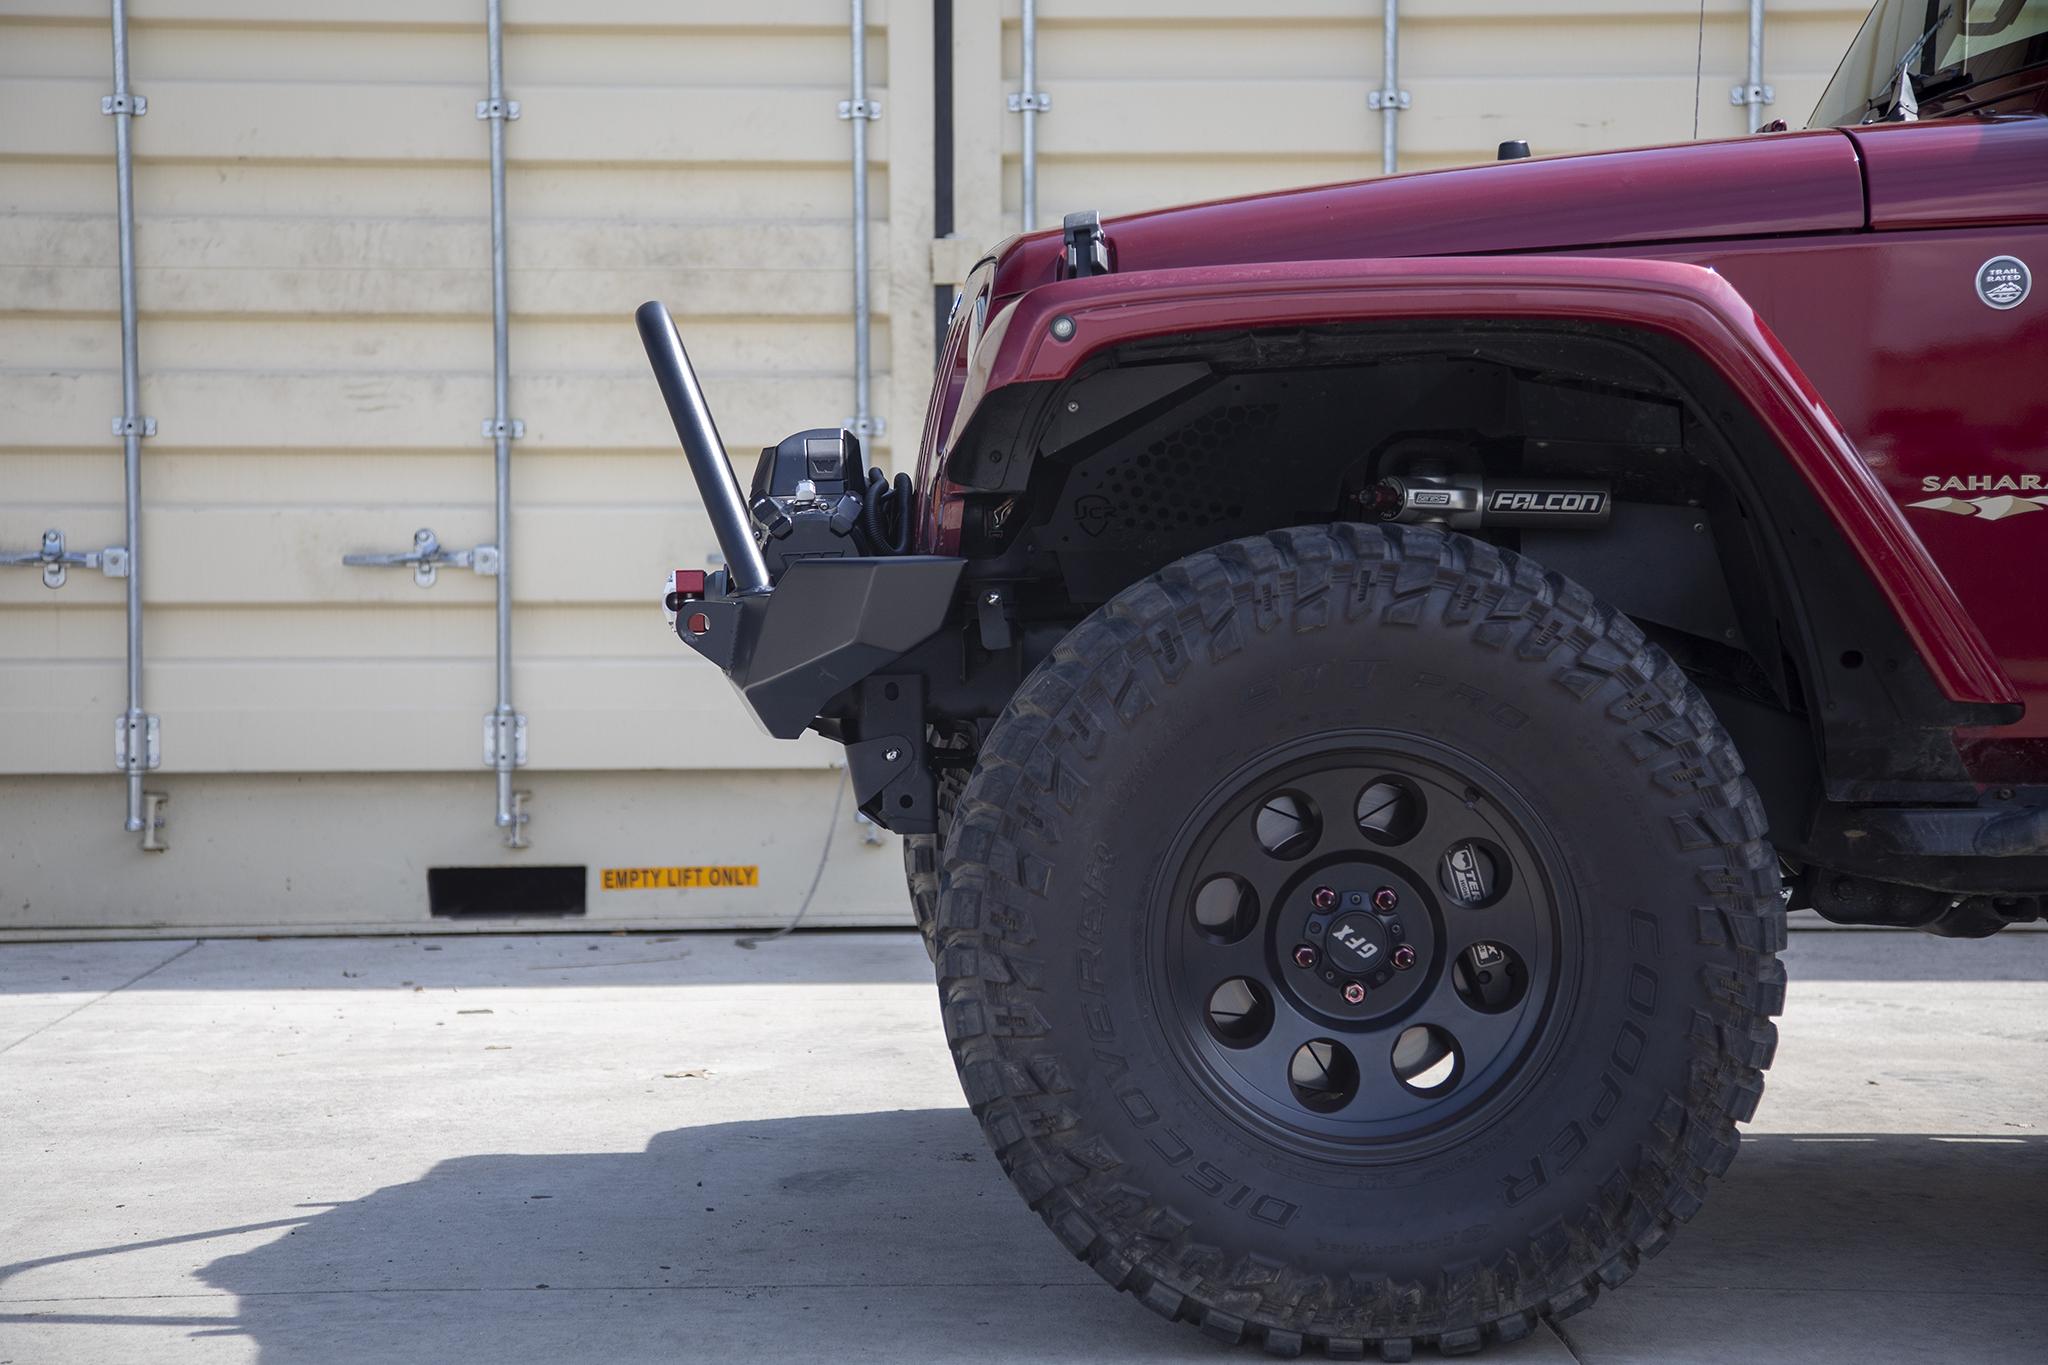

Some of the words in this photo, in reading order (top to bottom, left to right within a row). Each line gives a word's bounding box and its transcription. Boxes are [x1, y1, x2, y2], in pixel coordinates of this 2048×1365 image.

[1986, 274, 2021, 282] RATED
[1989, 268, 2019, 276] TRAIL
[1921, 474, 2048, 492] SAHAR
[1493, 492, 1600, 511] FALCON
[603, 869, 661, 889] EMPTY
[667, 868, 703, 888] LIFT
[708, 867, 755, 887] ONLY
[1332, 924, 1378, 959] GFX
[1496, 906, 1663, 1208] COOPER
